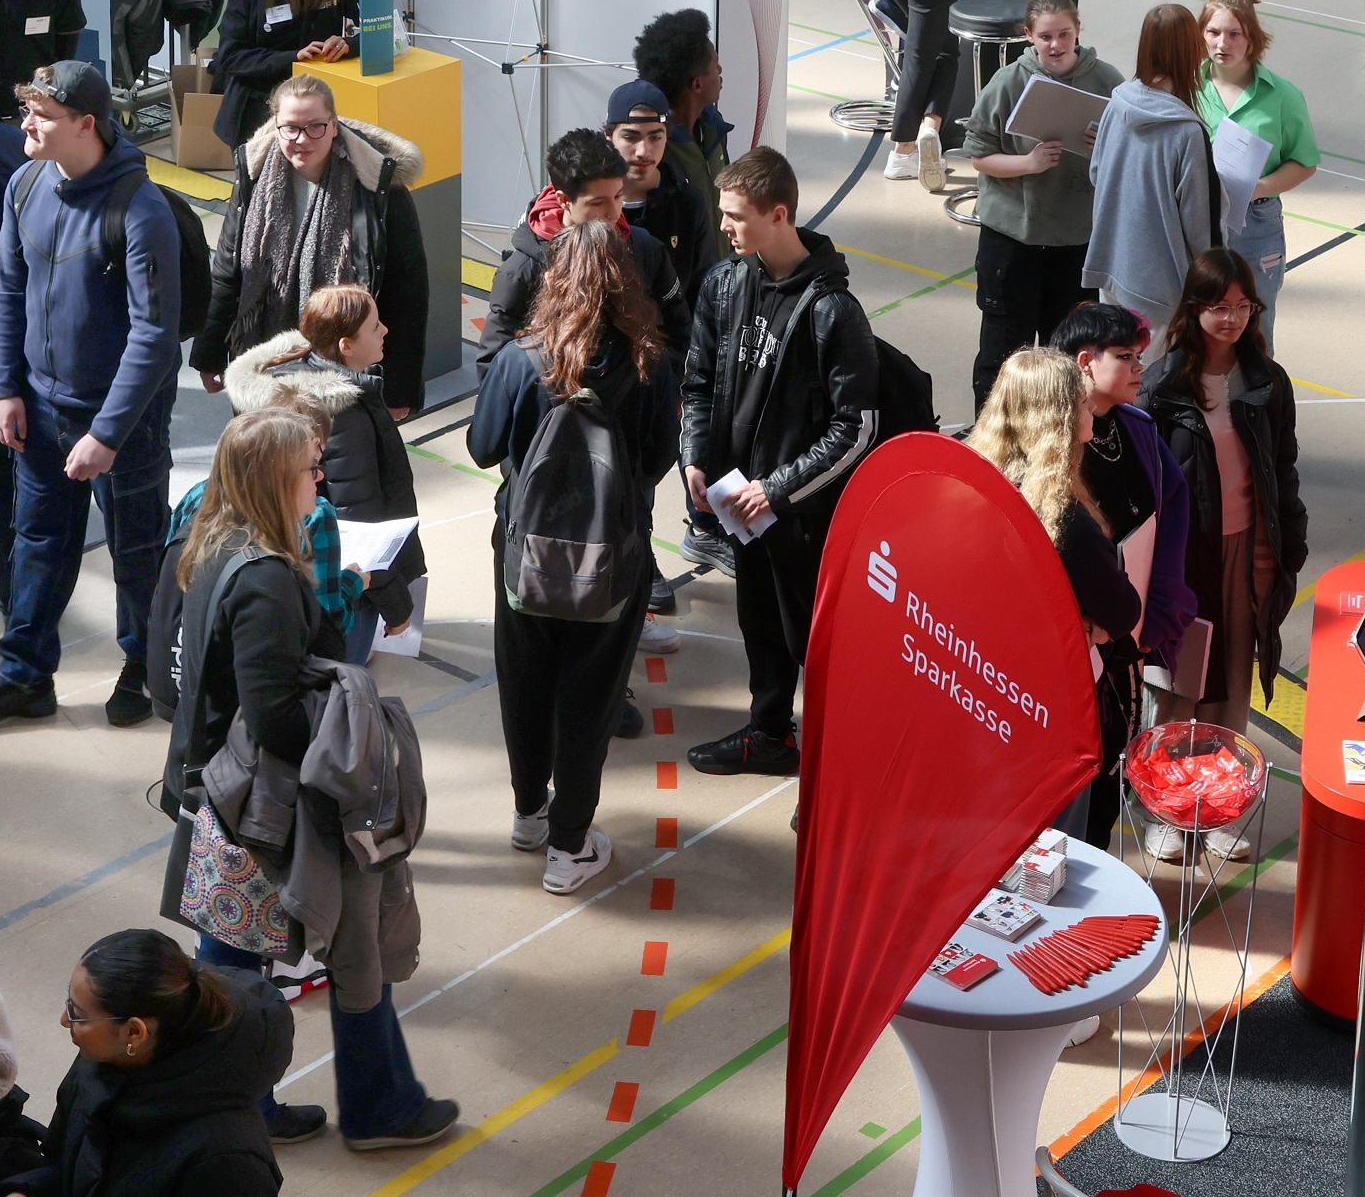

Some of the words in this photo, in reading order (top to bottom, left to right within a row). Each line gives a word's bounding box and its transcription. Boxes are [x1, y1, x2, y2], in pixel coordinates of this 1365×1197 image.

[363, 24, 376, 33] BEI
[377, 22, 393, 31] UNS.
[900, 633, 1012, 744] Sparkasse
[905, 590, 1050, 729] Rheinhessen
